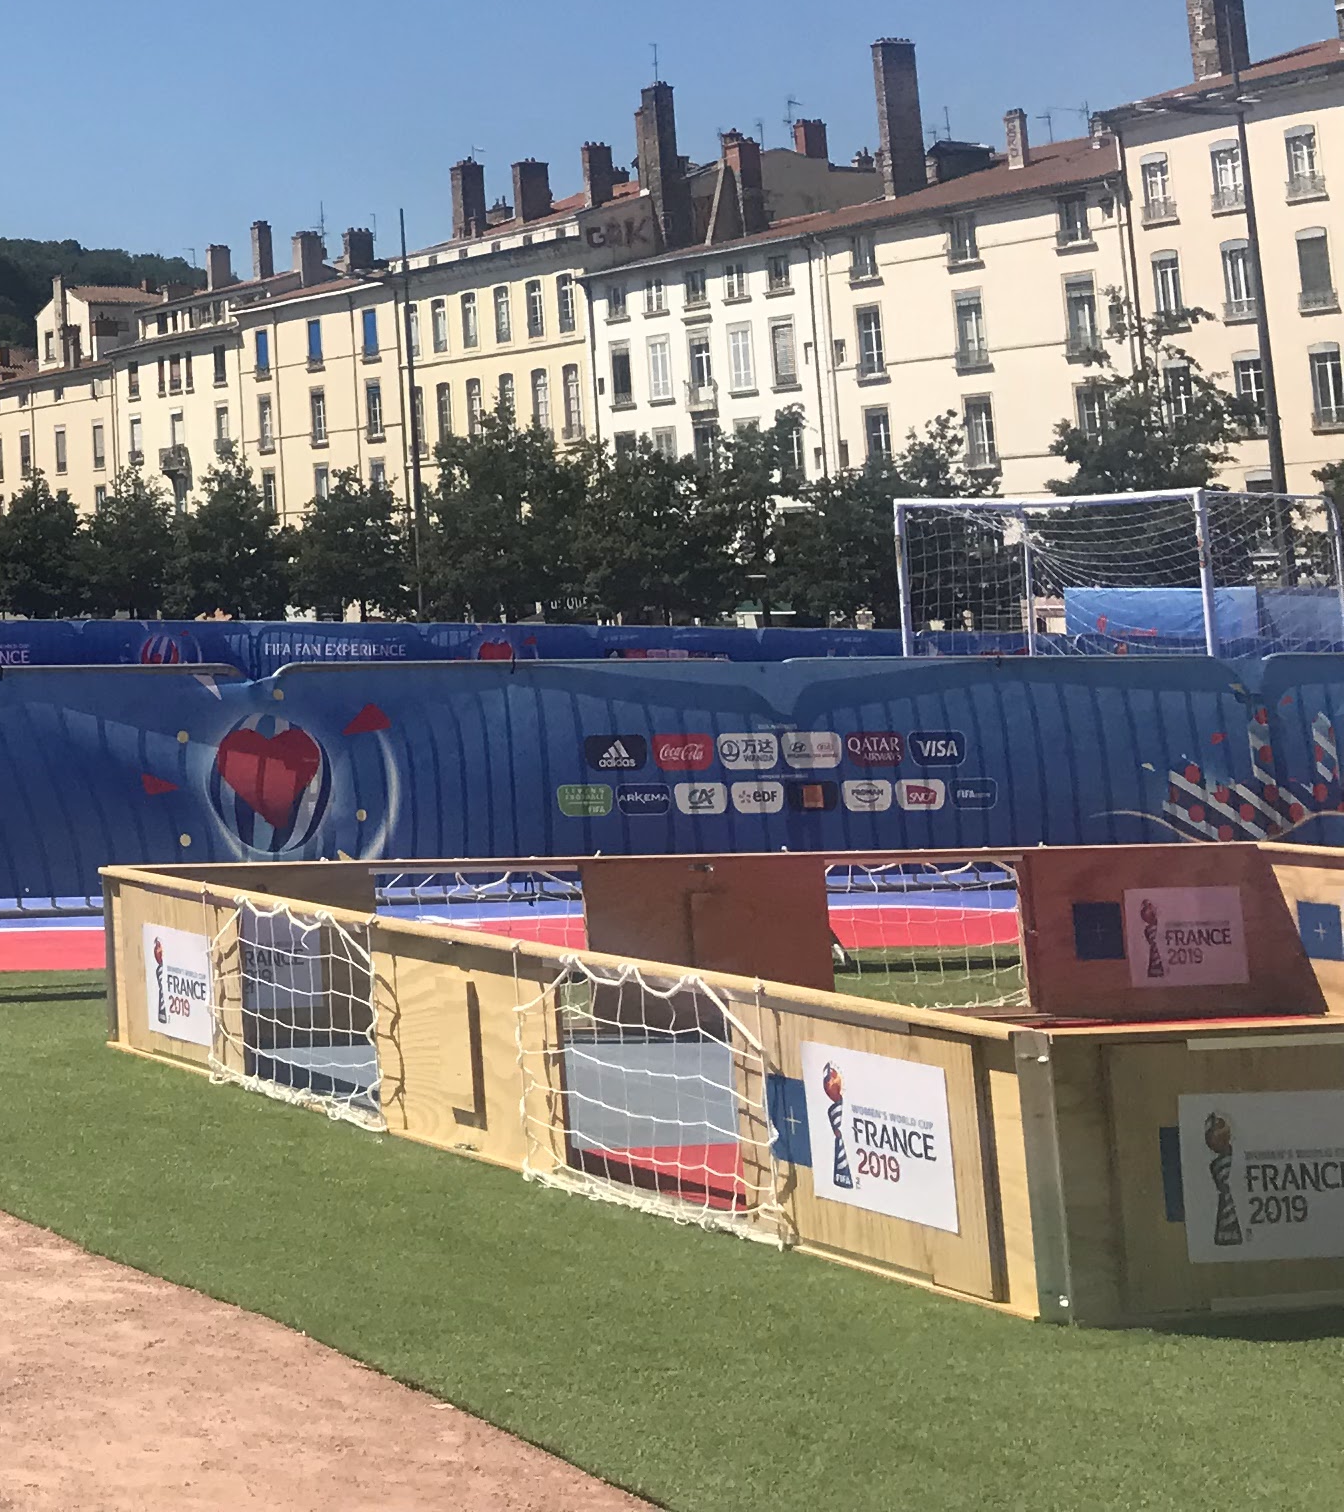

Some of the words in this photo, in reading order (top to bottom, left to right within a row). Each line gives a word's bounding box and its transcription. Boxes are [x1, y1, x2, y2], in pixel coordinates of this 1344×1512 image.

[265, 643, 291, 656] FIFA
[295, 643, 321, 656] FAN
[325, 643, 407, 657] EXPERIENCE
[741, 739, 774, 754] 万达
[847, 737, 900, 755] QATAR
[916, 740, 959, 757] VISA
[599, 757, 636, 768] adidas
[743, 753, 775, 762] WANDA
[863, 752, 902, 762] AIRWAYS
[618, 792, 670, 803] ARKEMA
[908, 792, 936, 803] SNCF
[1165, 928, 1232, 947] FRANCE
[244, 948, 305, 967] RANCE
[1167, 947, 1204, 965] 2019
[167, 974, 206, 1001] FRANCE
[169, 995, 190, 1018] 2019
[889, 1112, 917, 1127] WORLD
[917, 1119, 934, 1130] CUP
[851, 1117, 937, 1162] FRANCE
[855, 1148, 901, 1183] 2019
[1248, 1194, 1309, 1225] 2019
